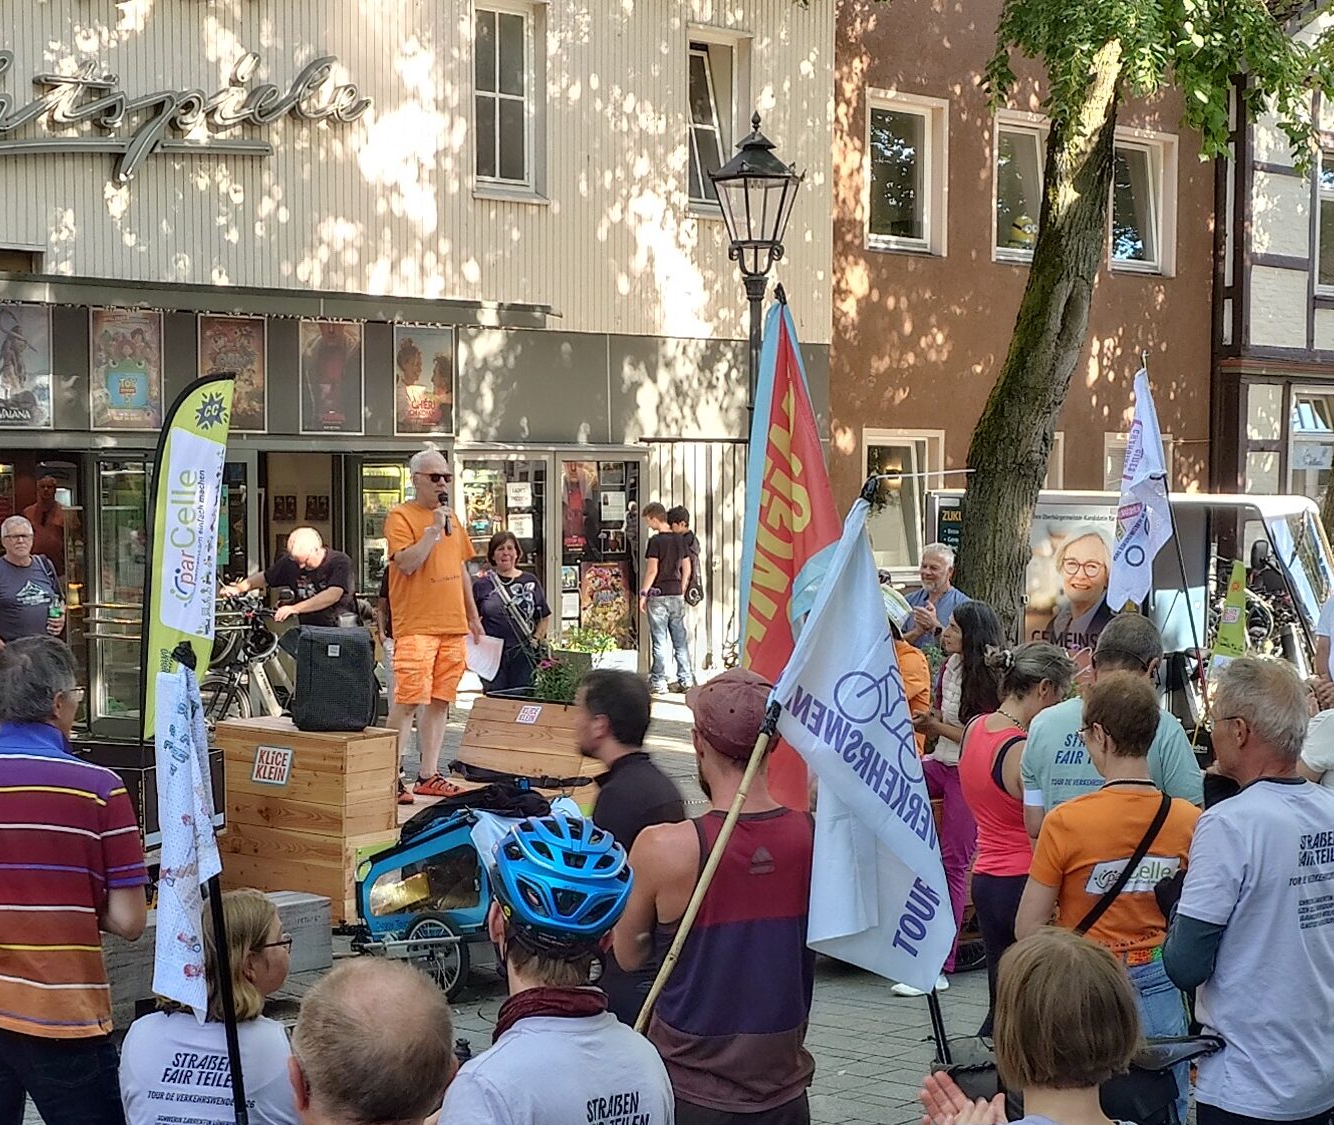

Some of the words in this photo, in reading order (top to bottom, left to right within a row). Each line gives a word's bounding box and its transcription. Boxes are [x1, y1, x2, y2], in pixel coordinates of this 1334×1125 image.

[204, 403, 219, 416] CC
[942, 510, 962, 521] ZUK
[170, 468, 199, 588] parCelle
[1031, 628, 1099, 649] GEMEINS
[1055, 751, 1084, 764] FAIR
[255, 765, 286, 782] KLEIN
[161, 1068, 193, 1085] FAIR
[196, 1071, 234, 1089] TEILE
[147, 1090, 165, 1101] TOUR
[165, 1092, 175, 1101] DE
[586, 1091, 640, 1123] STRAßEN
